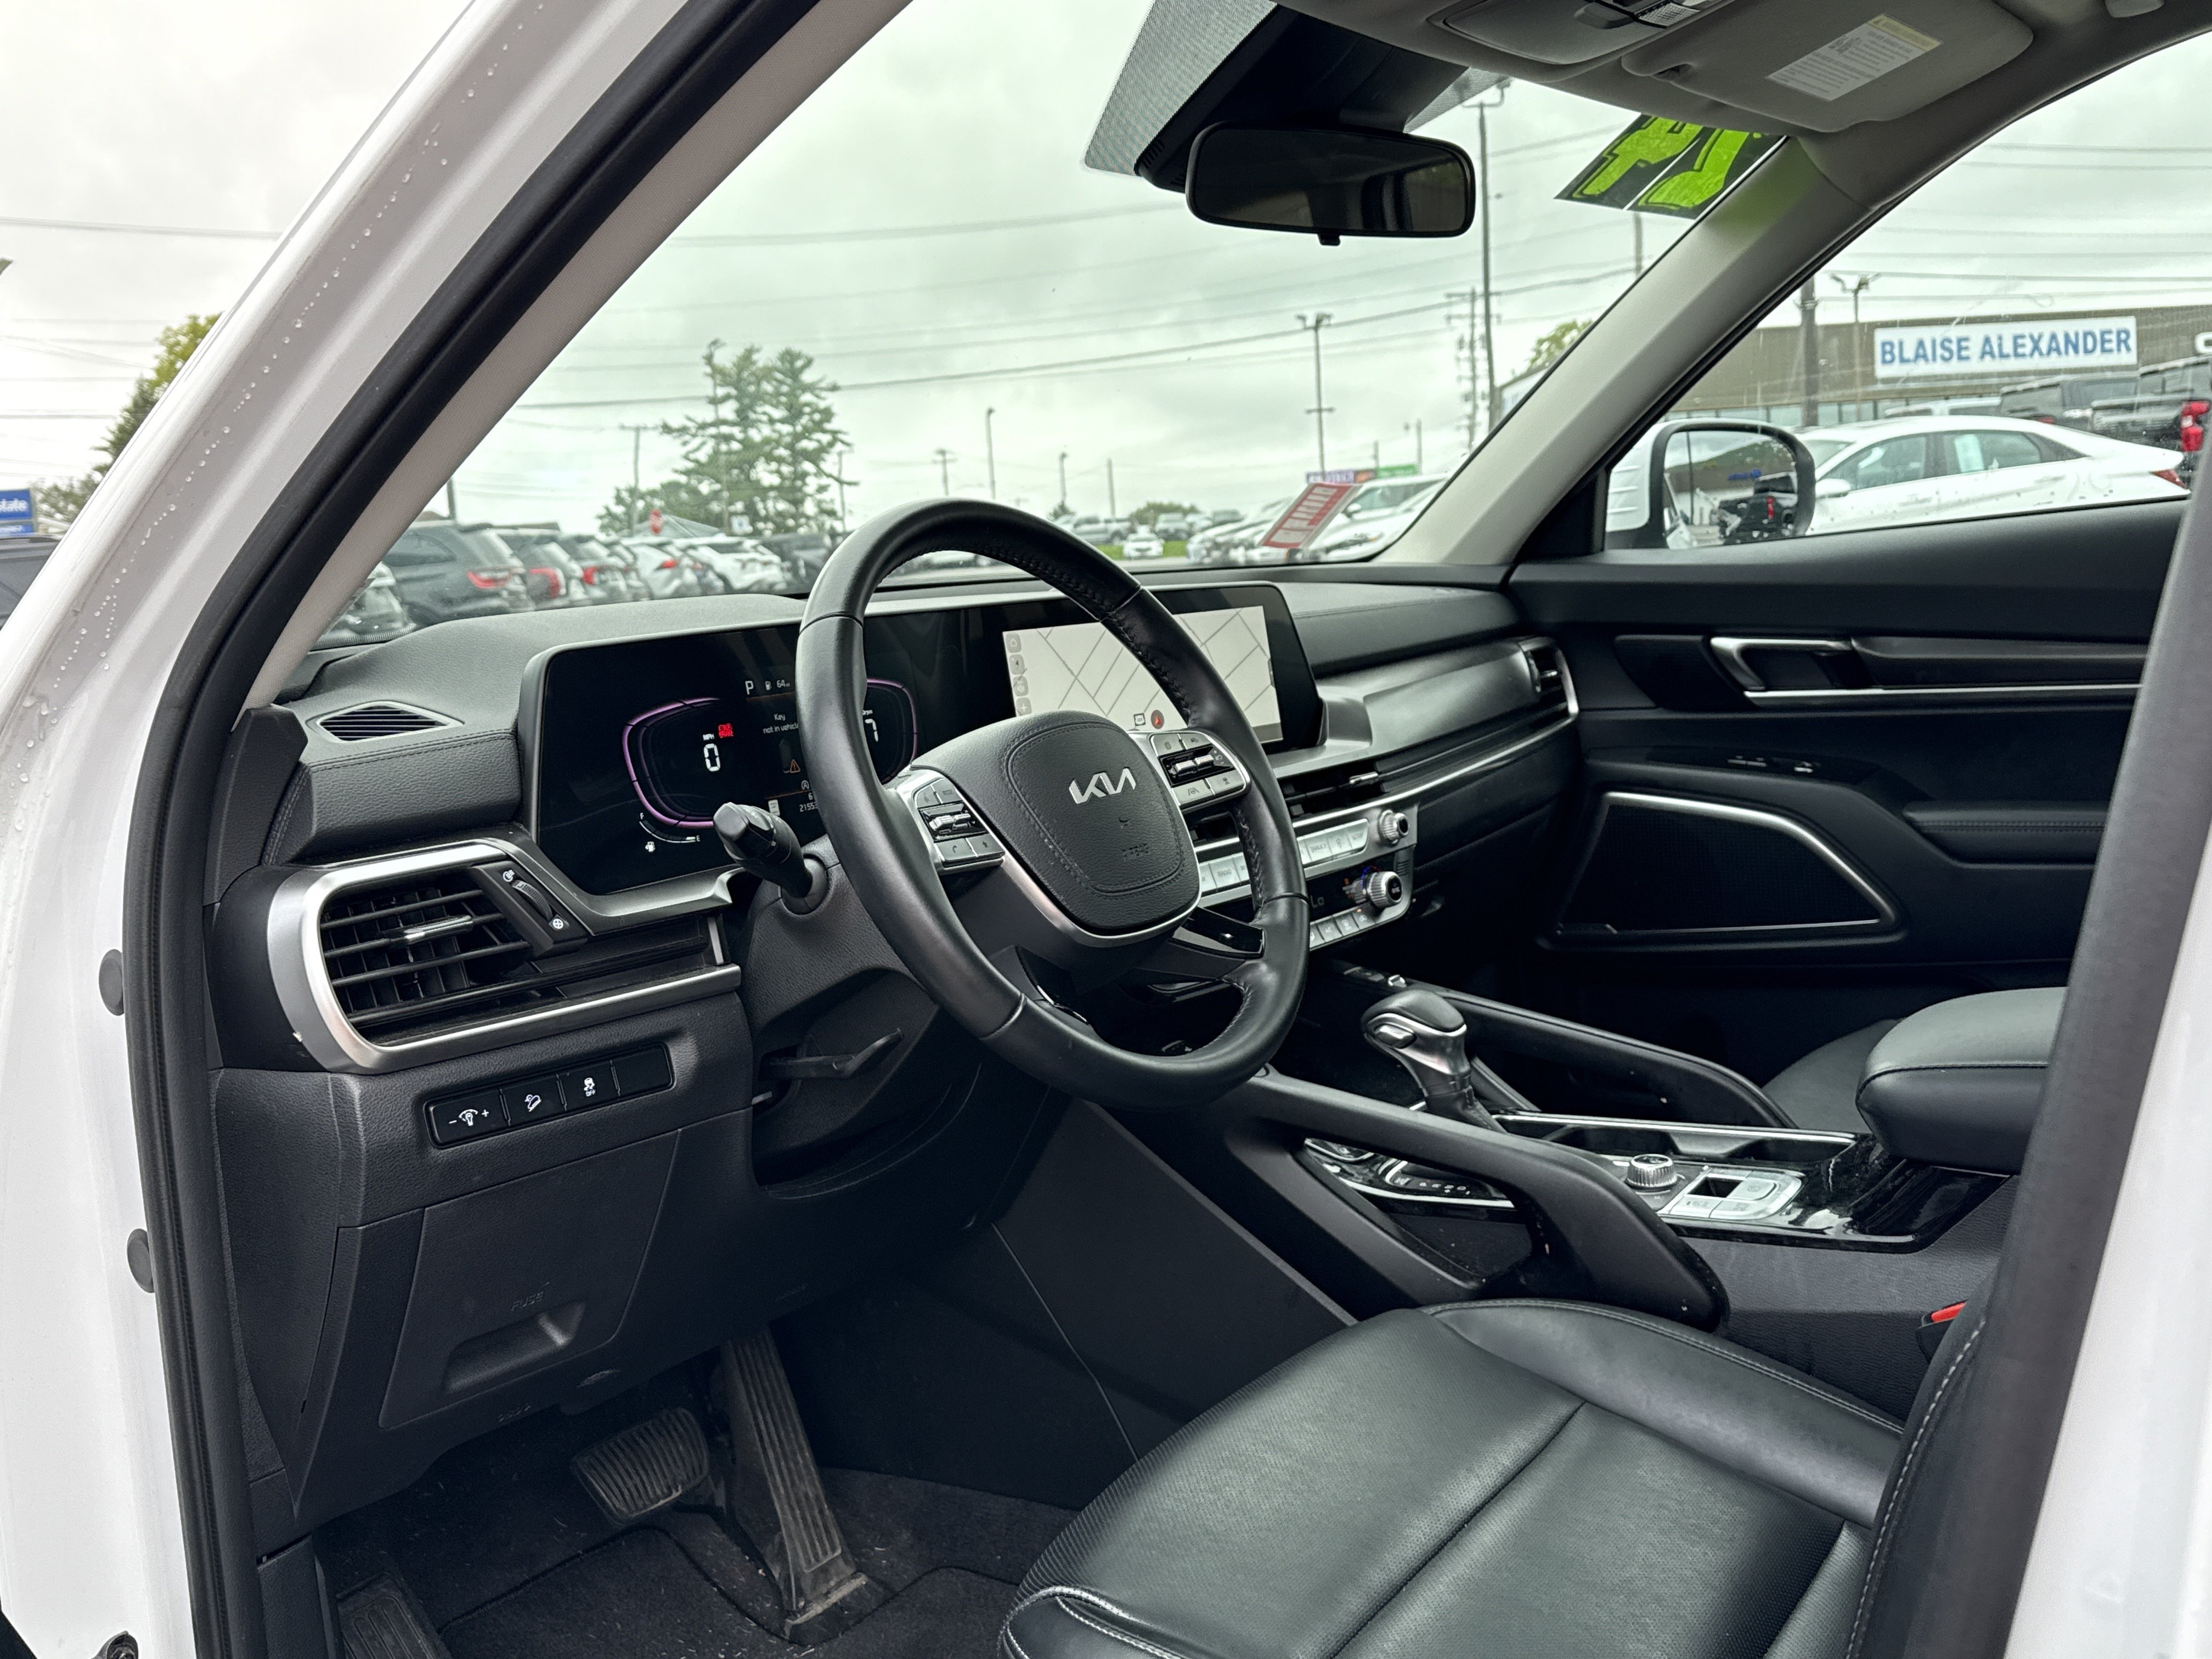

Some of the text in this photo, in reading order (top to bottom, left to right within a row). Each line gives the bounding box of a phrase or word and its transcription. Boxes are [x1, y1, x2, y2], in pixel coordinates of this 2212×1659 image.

[1881, 327, 2132, 365] BLAISE ALEXANDER
[745, 680, 754, 695] P
[763, 726, 774, 734] not
[703, 743, 721, 772] 0
[1069, 768, 1136, 804] KIA
